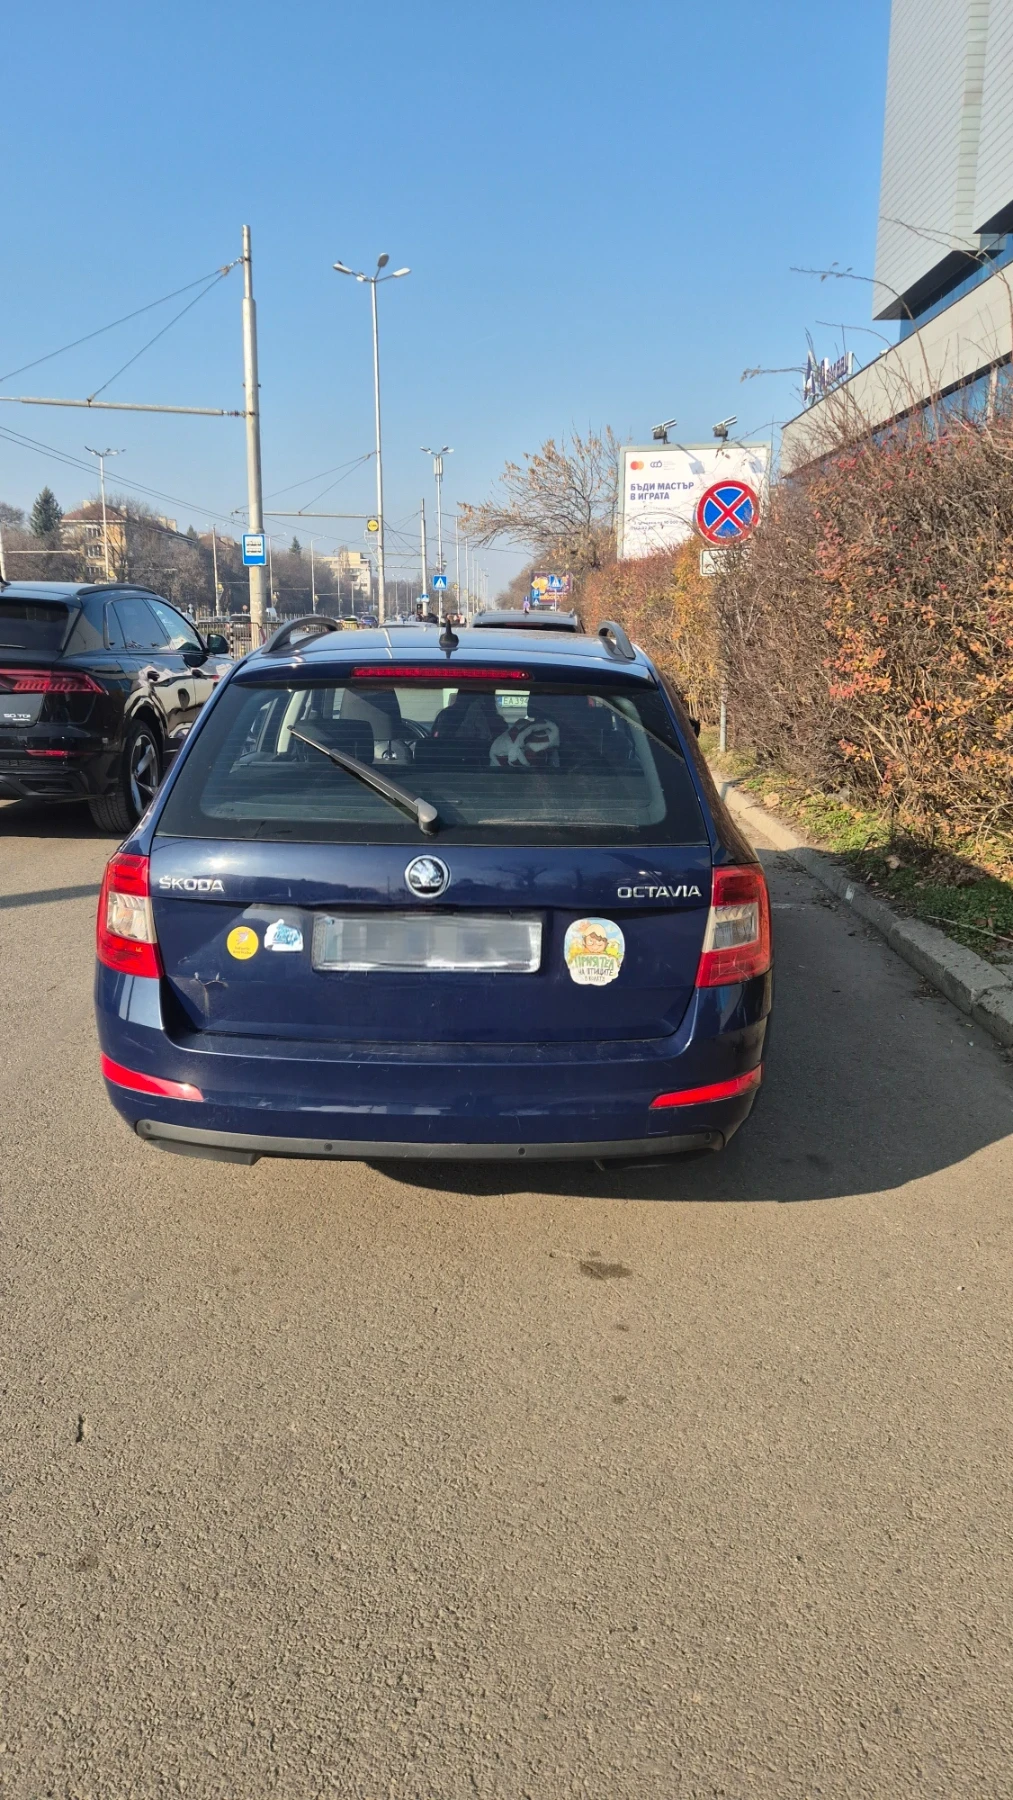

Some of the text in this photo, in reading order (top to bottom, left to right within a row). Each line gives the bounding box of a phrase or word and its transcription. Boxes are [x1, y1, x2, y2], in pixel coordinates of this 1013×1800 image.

[630, 482, 694, 492] БЪДИ МАСТЪР
[630, 492, 670, 501] В ИГРАТА
[158, 875, 225, 892] ŠKODA
[617, 885, 702, 899] OCTAVIA
[574, 956, 614, 970] ПРИЯТЕЛ
